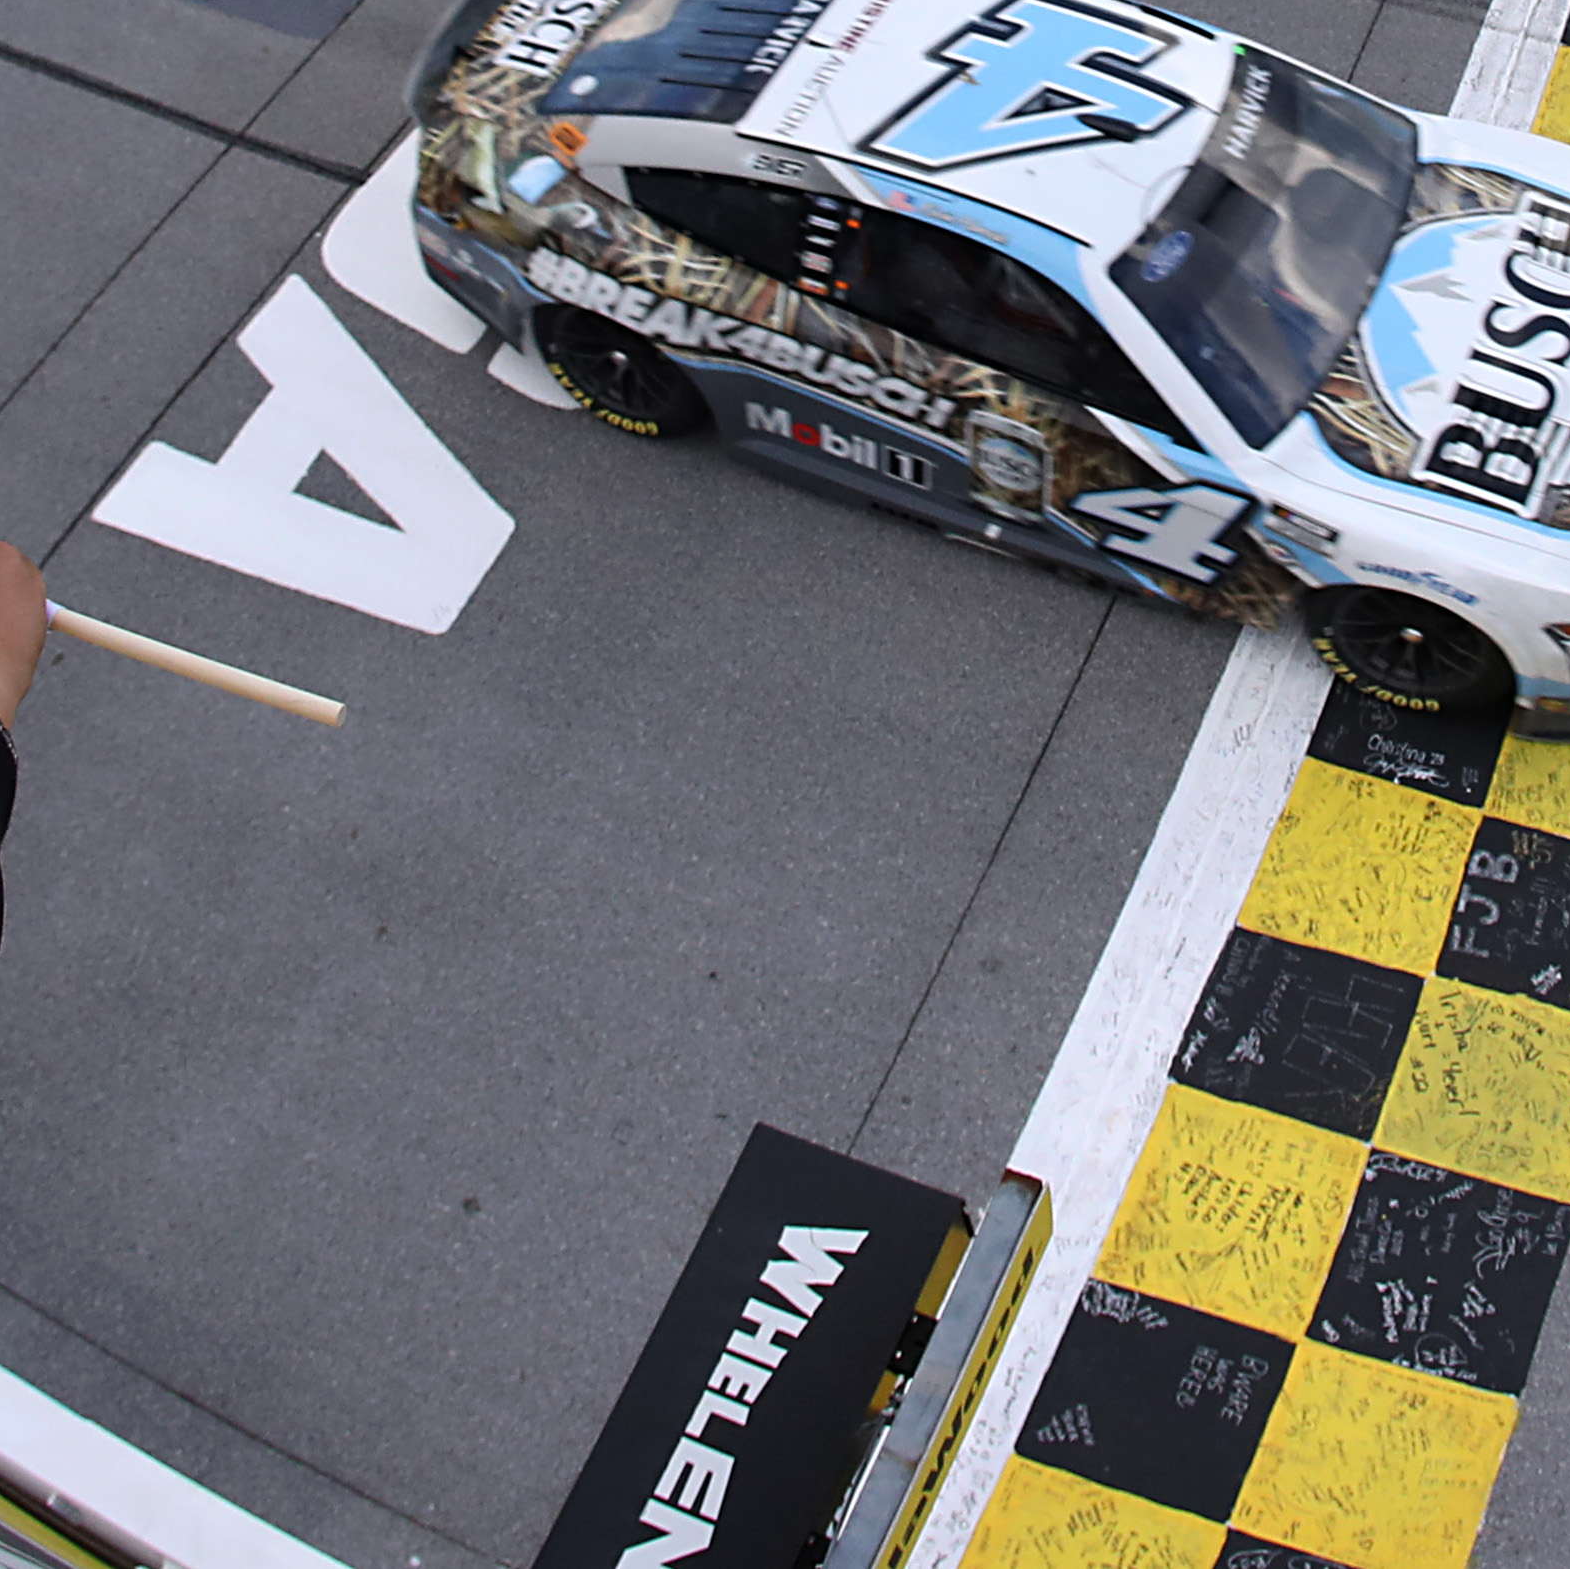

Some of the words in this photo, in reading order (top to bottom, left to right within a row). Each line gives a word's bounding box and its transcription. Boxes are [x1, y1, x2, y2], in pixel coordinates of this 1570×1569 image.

[774, 50, 846, 139] AUCTION
[1221, 63, 1273, 160] HARVICK
[529, 245, 957, 431] #BREAK4BUSCH
[743, 401, 878, 472] Mobil
[1069, 483, 1254, 585] 4
